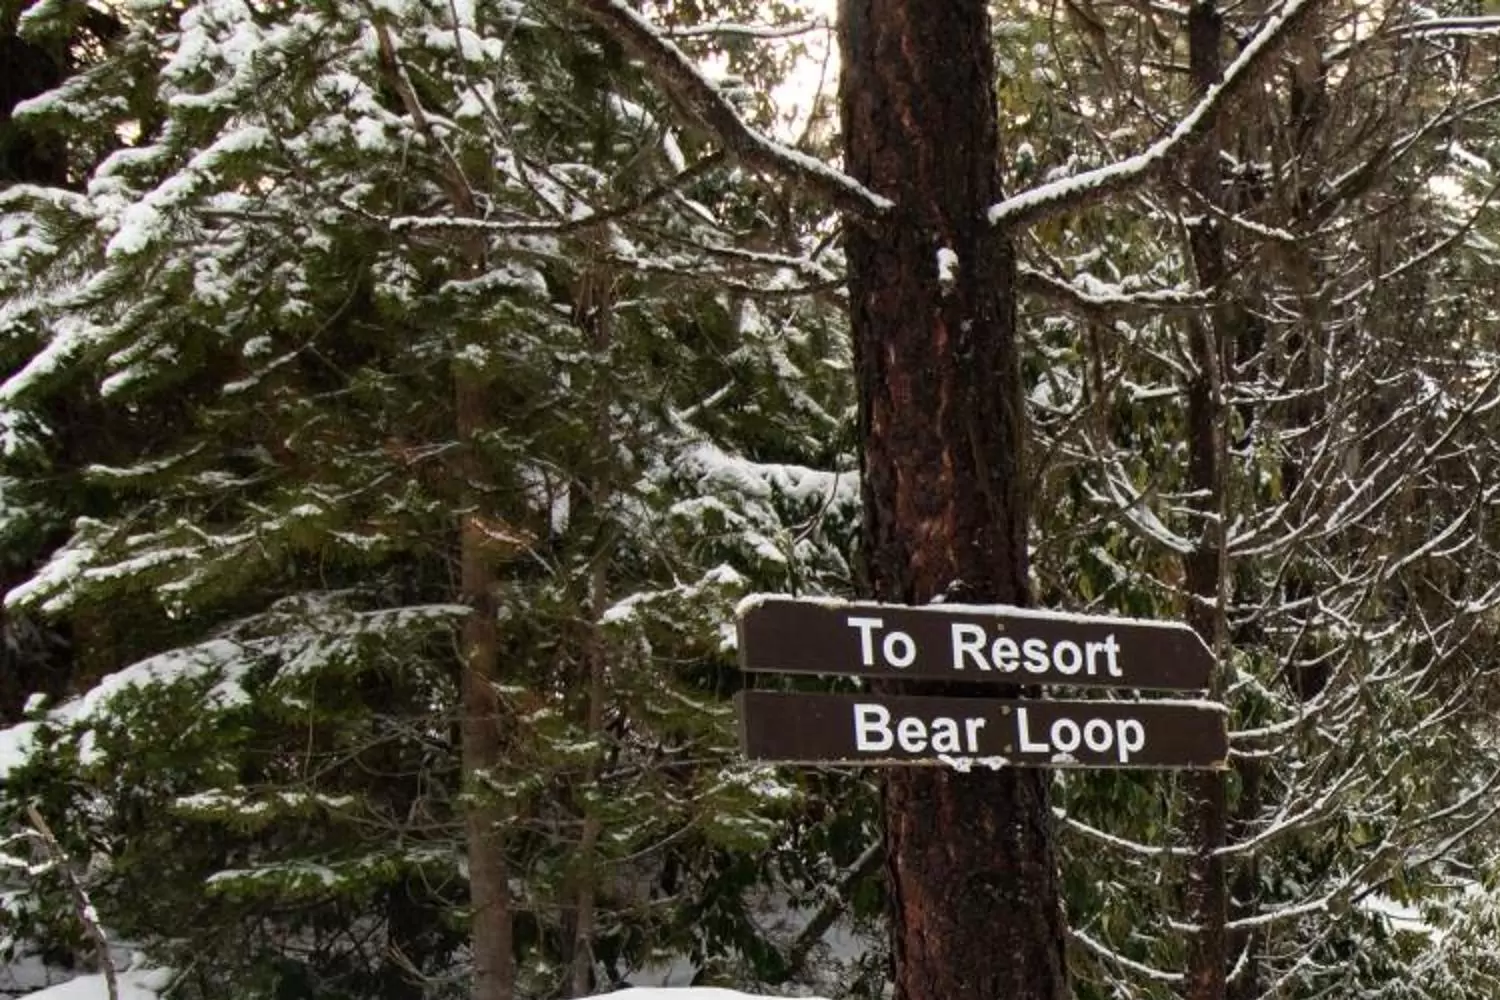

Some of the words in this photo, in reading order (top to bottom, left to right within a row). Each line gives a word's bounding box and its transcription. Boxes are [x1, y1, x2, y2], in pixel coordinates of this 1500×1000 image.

[847, 616, 917, 668] To
[951, 623, 1123, 677] Resort
[853, 703, 986, 753] Bear
[1017, 707, 1146, 763] Loop
